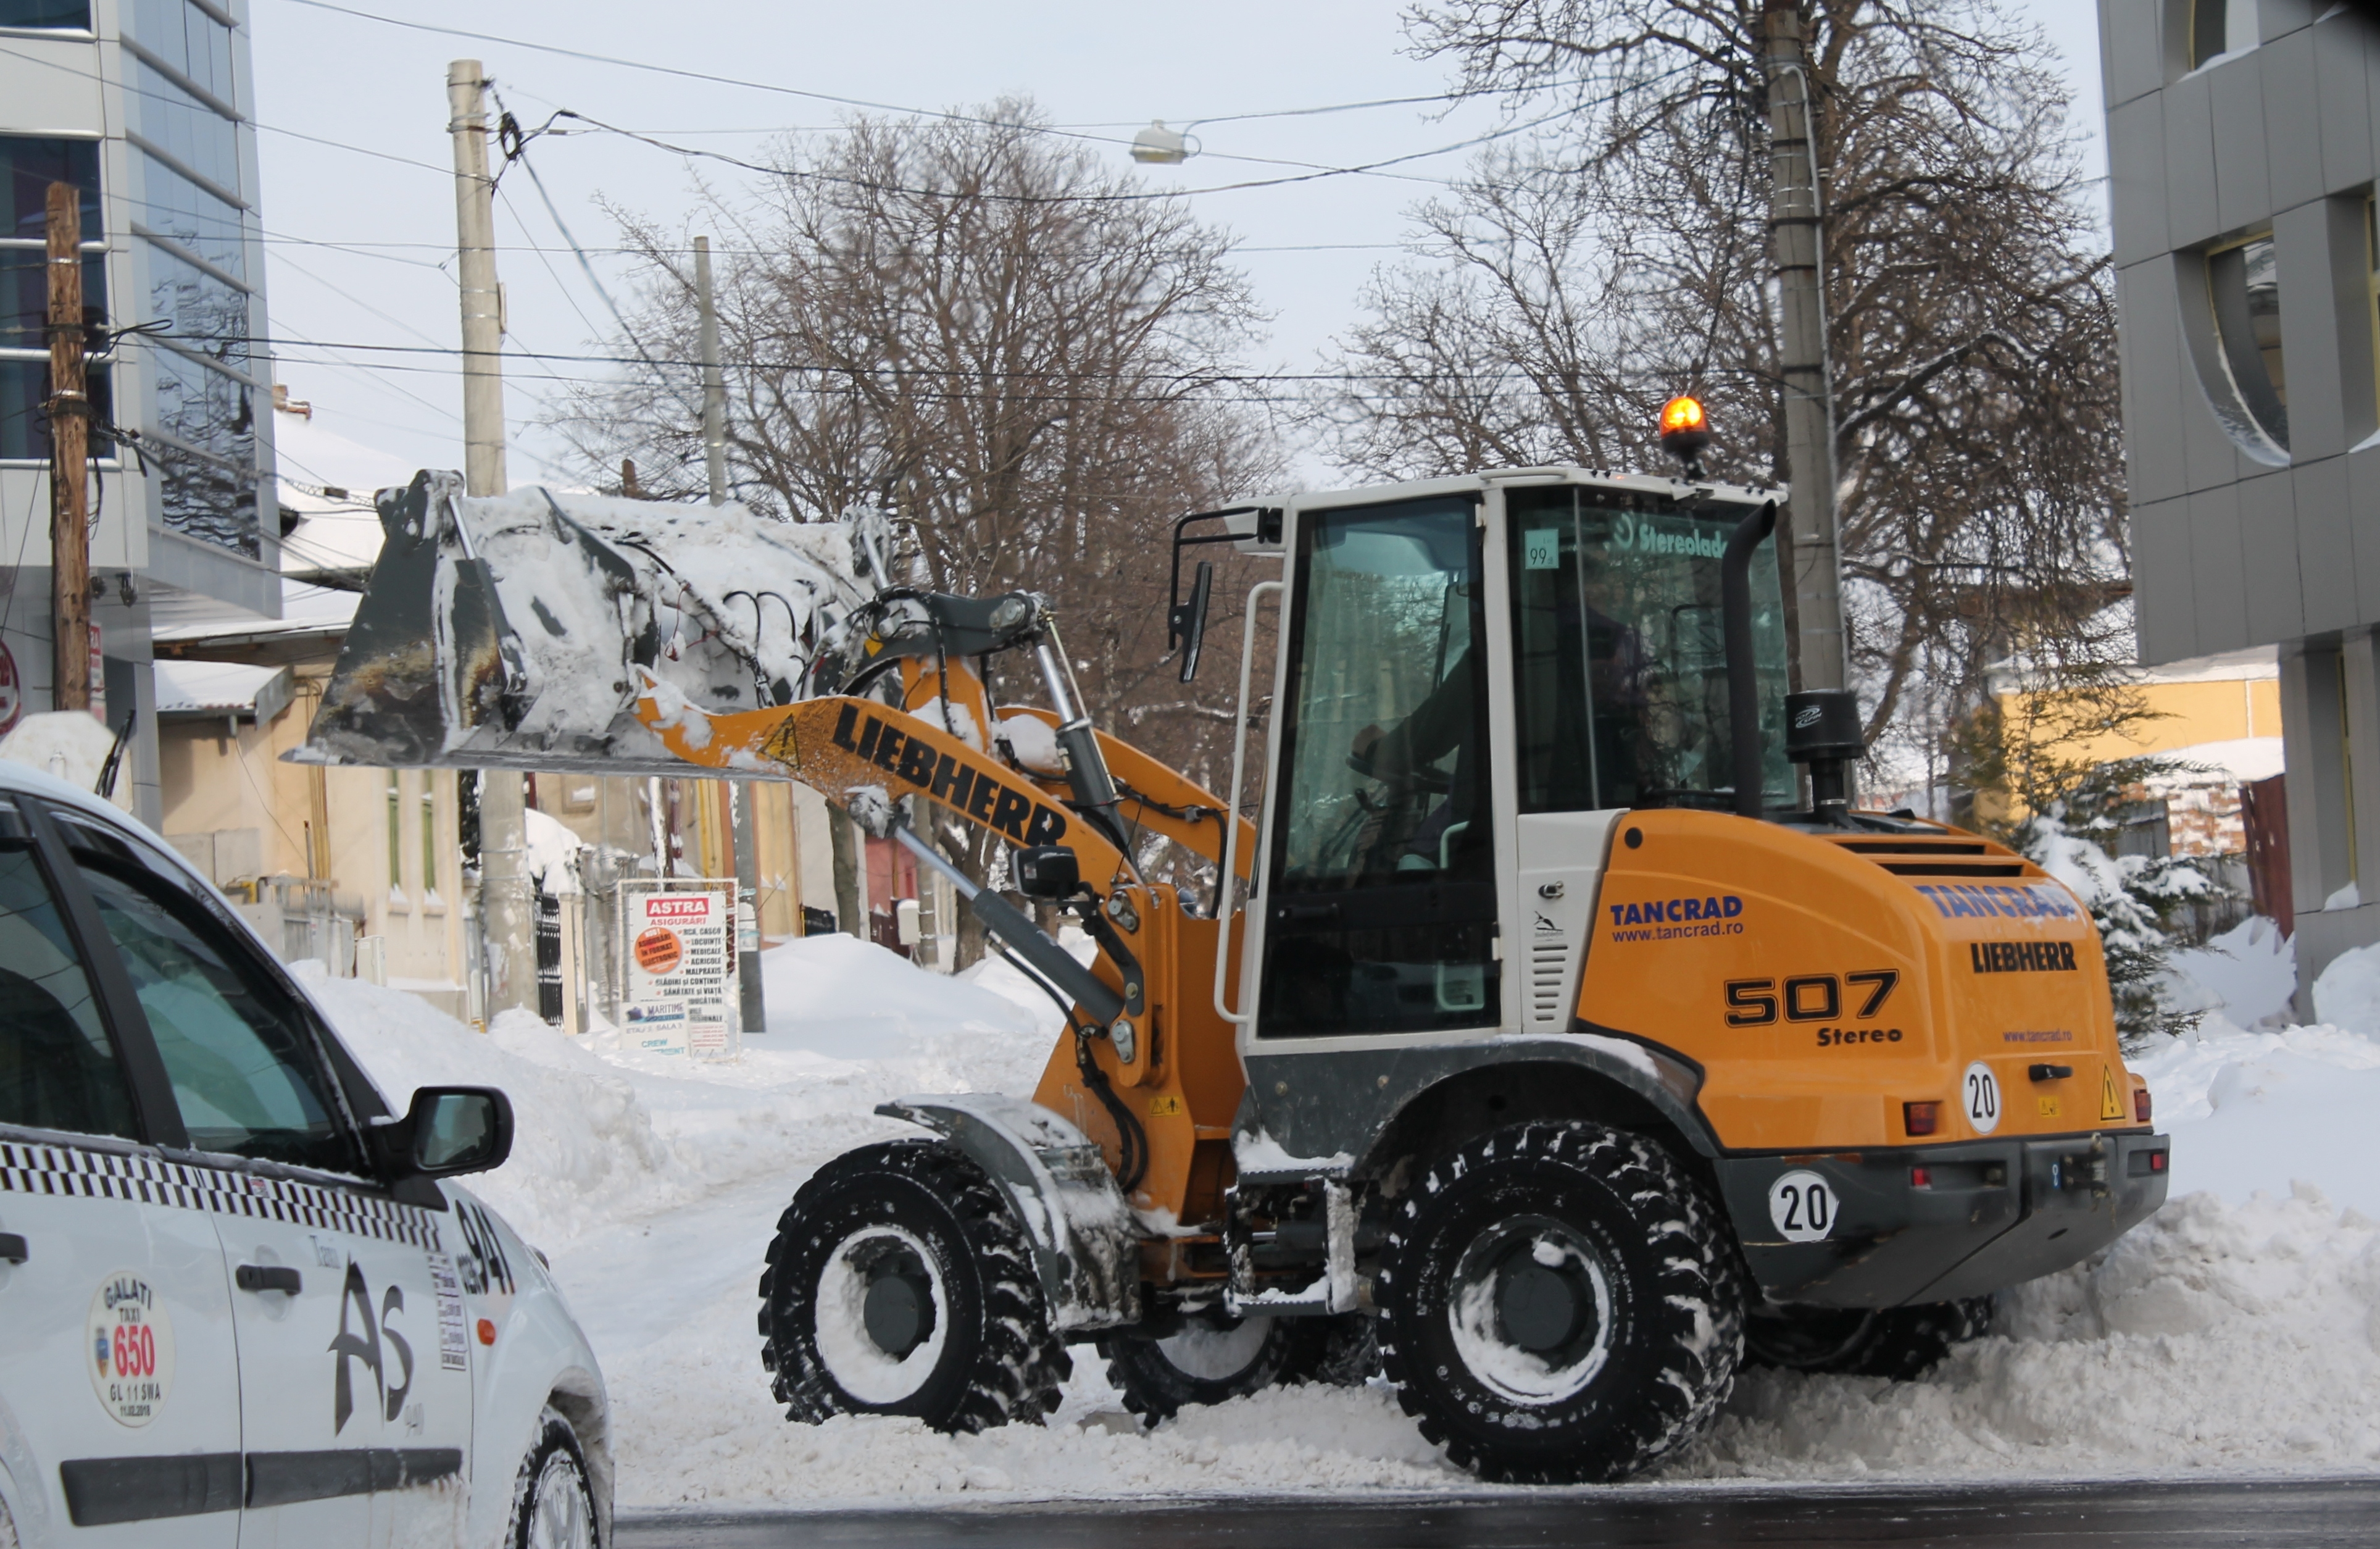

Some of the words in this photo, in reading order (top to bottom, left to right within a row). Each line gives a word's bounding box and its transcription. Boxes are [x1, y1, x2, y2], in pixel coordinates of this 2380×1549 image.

[1530, 548, 1547, 565] 99
[832, 702, 1067, 846] LIEBHERR
[649, 900, 707, 915] ASTRA
[1610, 895, 1743, 926] TANCRAD
[1612, 920, 1744, 943] www.tancrad.ro
[690, 947, 722, 956] MEDICALE
[1970, 942, 2078, 974] LIEBHERR
[685, 967, 722, 975] MALPRAXIS
[1724, 969, 1900, 1029] 507
[647, 1002, 684, 1016] MARITIME
[641, 1038, 668, 1048] CREW
[1816, 1027, 1904, 1047] Stereo
[2002, 1028, 2073, 1042] www.tancrad.ro
[1968, 1073, 1996, 1119] 20
[1779, 1184, 1828, 1232] 20
[118, 1307, 141, 1324] TAXI
[114, 1324, 156, 1377] 650
[110, 1384, 123, 1401] GL
[141, 1382, 160, 1401] SWA
